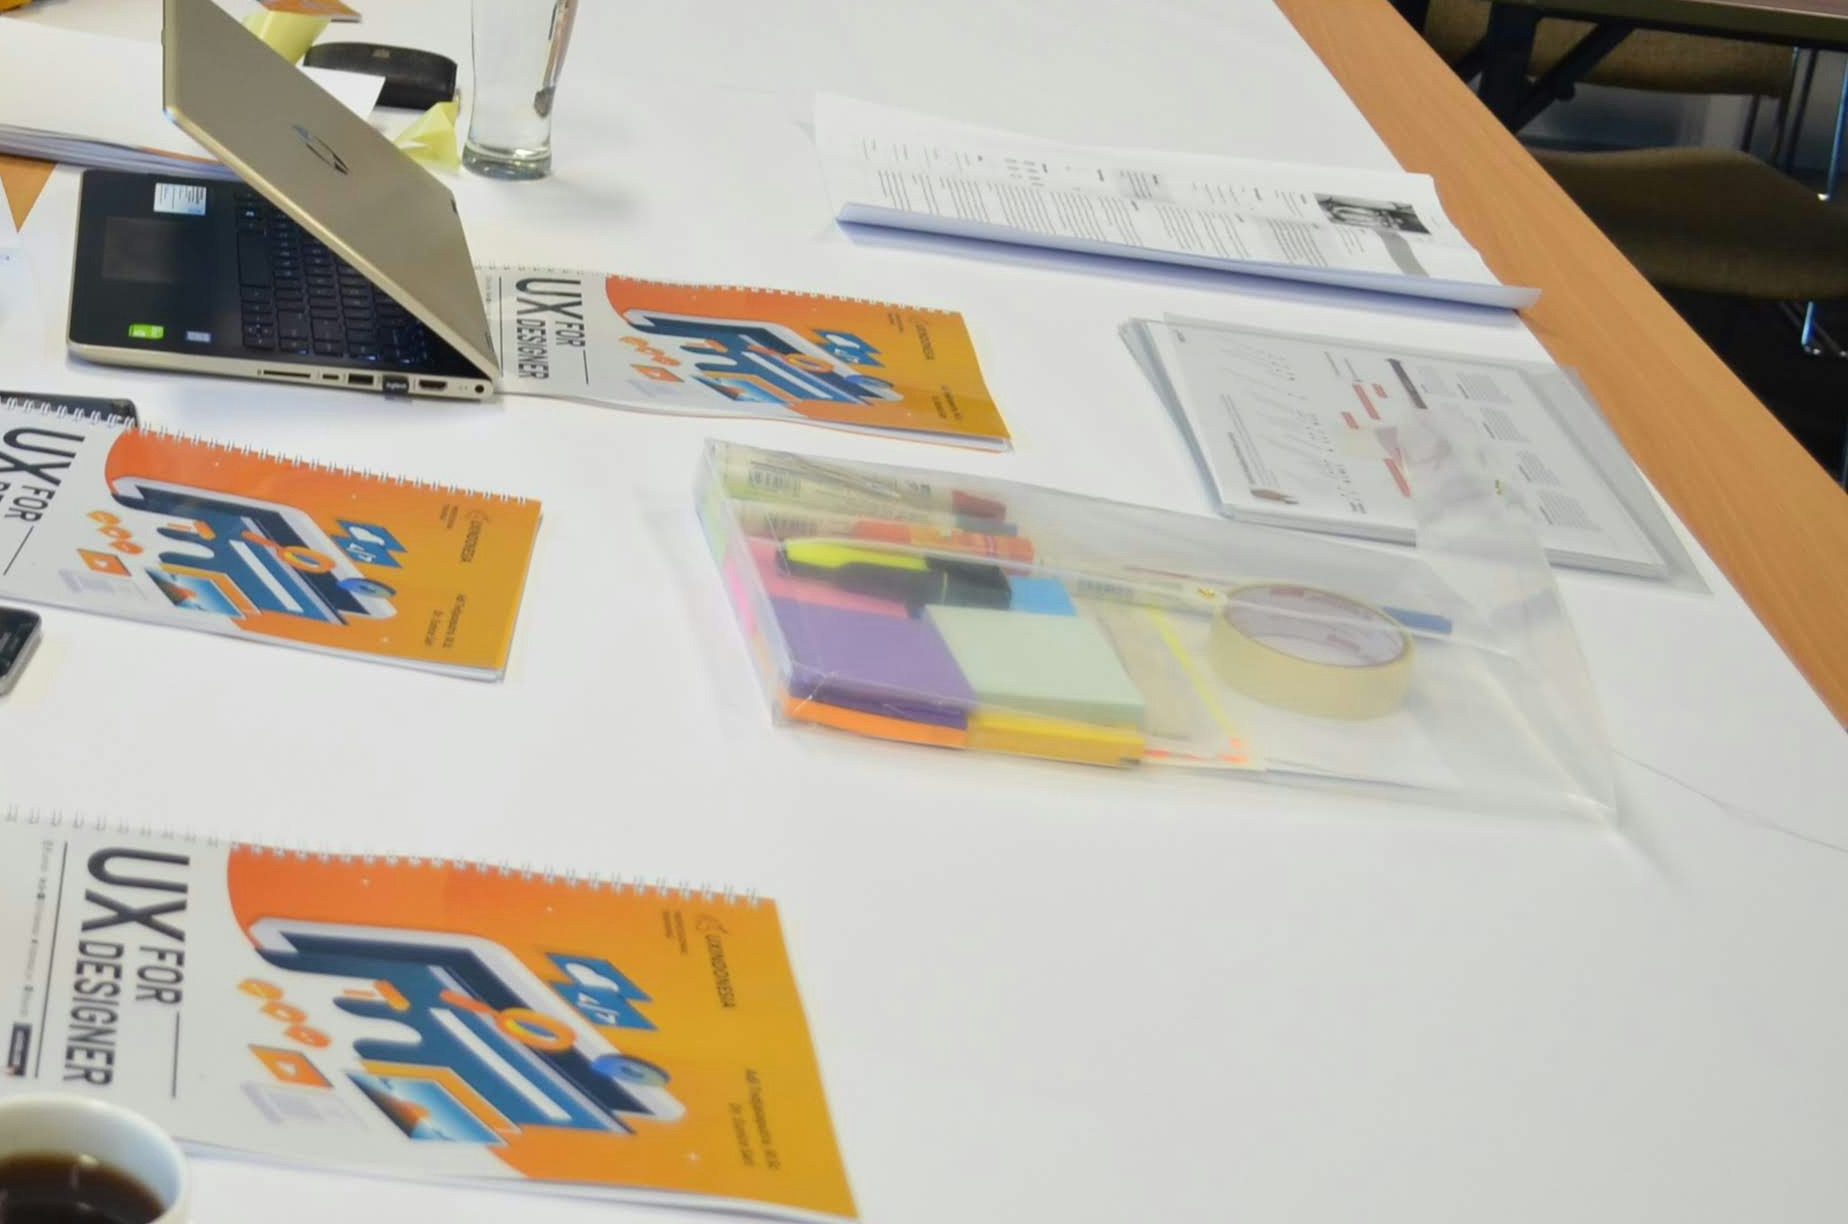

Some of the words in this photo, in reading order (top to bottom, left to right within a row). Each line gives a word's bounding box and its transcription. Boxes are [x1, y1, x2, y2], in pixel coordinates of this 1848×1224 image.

[515, 278, 584, 320] UX
[555, 320, 586, 348] FOR
[516, 318, 550, 380] DESIGNER
[4, 484, 56, 523] FOR
[81, 846, 190, 943] UX
[135, 944, 185, 1006] FOR
[63, 939, 125, 1087] DESIGNER
